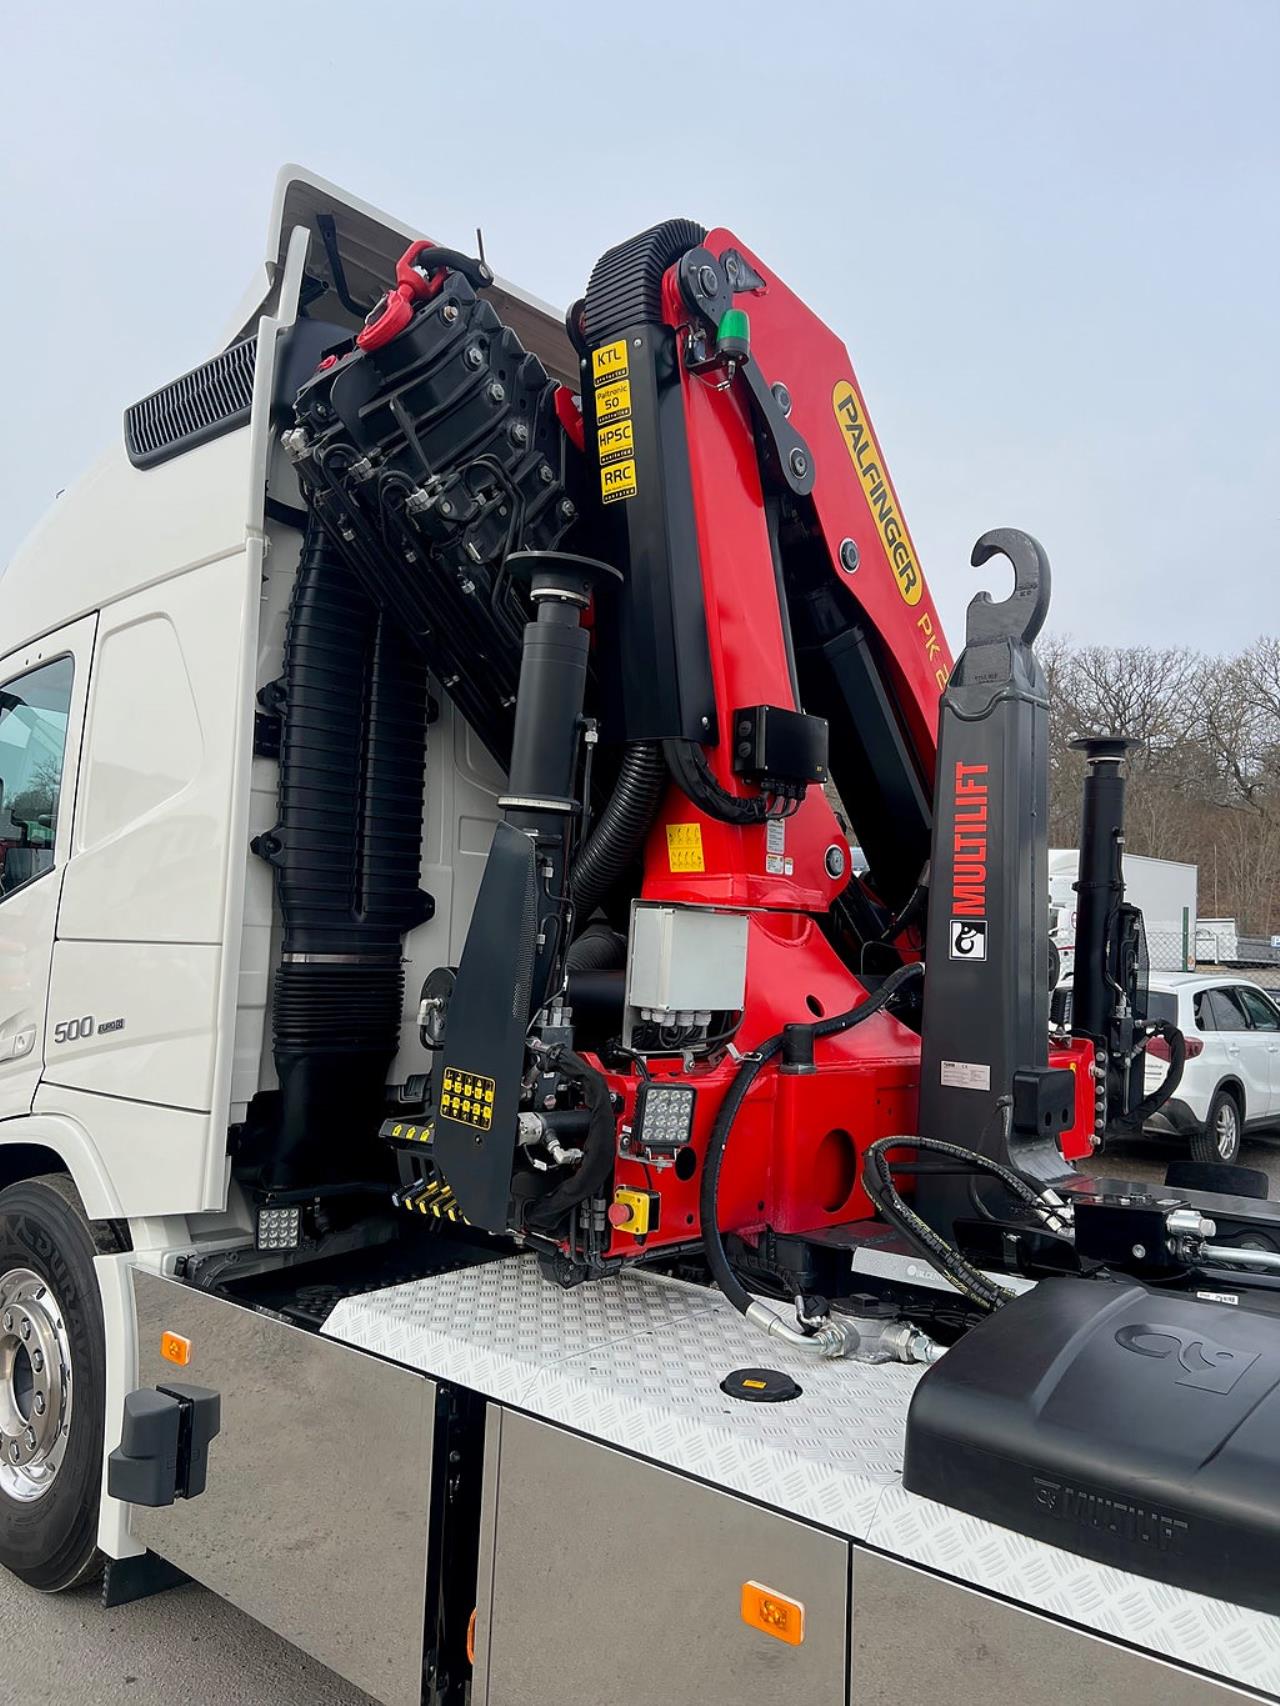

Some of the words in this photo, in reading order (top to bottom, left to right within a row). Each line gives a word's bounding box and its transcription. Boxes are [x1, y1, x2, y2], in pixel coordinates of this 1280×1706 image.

[598, 348, 621, 367] KTL
[605, 397, 619, 410] 50
[600, 426, 630, 447] HPSC
[605, 466, 631, 486] RRC
[837, 394, 916, 594] PALFINGER
[916, 612, 940, 659] PK
[952, 761, 989, 916] MULTILIFT
[54, 1015, 93, 1043] 500
